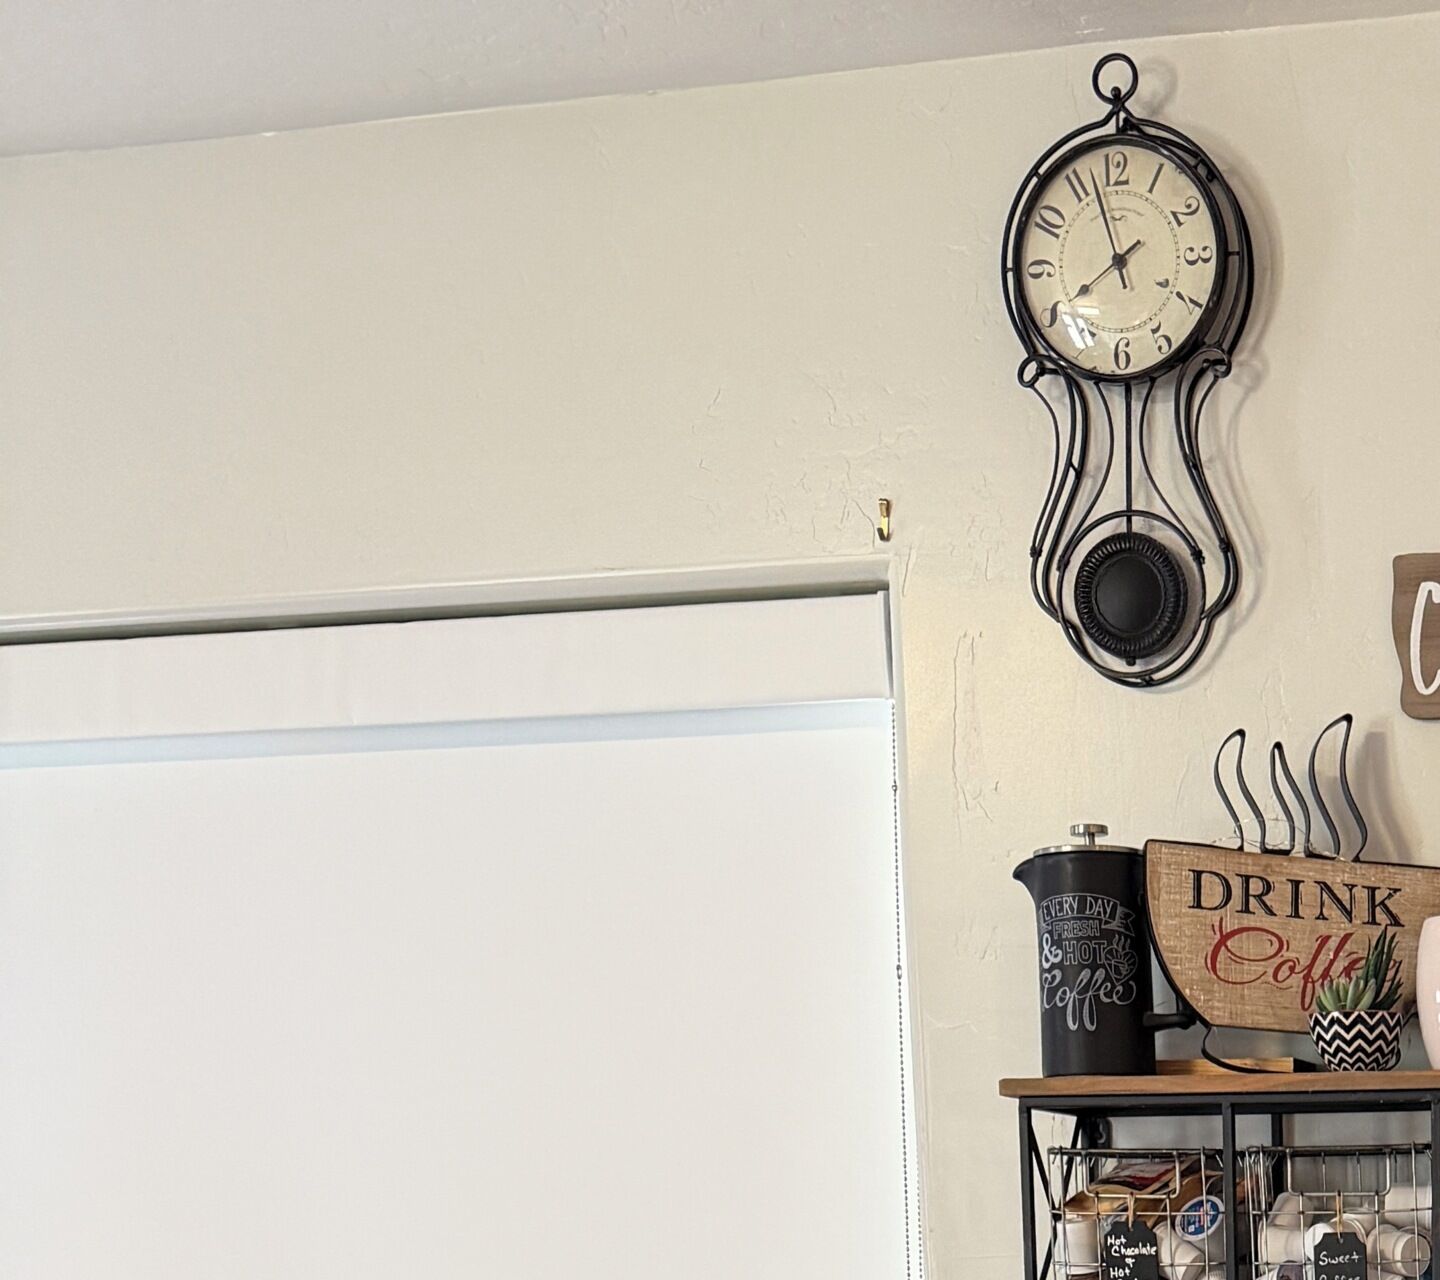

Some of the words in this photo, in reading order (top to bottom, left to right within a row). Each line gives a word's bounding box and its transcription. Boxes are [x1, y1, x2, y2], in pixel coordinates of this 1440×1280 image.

[1064, 167, 1090, 203] 11
[1103, 151, 1130, 187] 12
[1147, 162, 1165, 194] 1
[1034, 204, 1066, 240] 10
[1170, 195, 1200, 228] 2
[1027, 258, 1056, 280] 9
[1183, 245, 1213, 266] 3
[1175, 290, 1203, 316] 4
[1113, 336, 1131, 371] 6
[1150, 320, 1173, 355] 5
[1043, 896, 1079, 920] EVERY
[1086, 896, 1114, 921] DAY
[1188, 868, 1405, 928] DRINK
[1052, 920, 1100, 940] FRESH
[1042, 933, 1063, 969] &
[1062, 940, 1107, 965] HOT
[1042, 968, 1137, 1031] Coffee
[1107, 1234, 1127, 1246] Hot
[1111, 1242, 1157, 1256] Chocolate
[1110, 1267, 1130, 1278] Hot
[1318, 1250, 1362, 1266] Sweet
